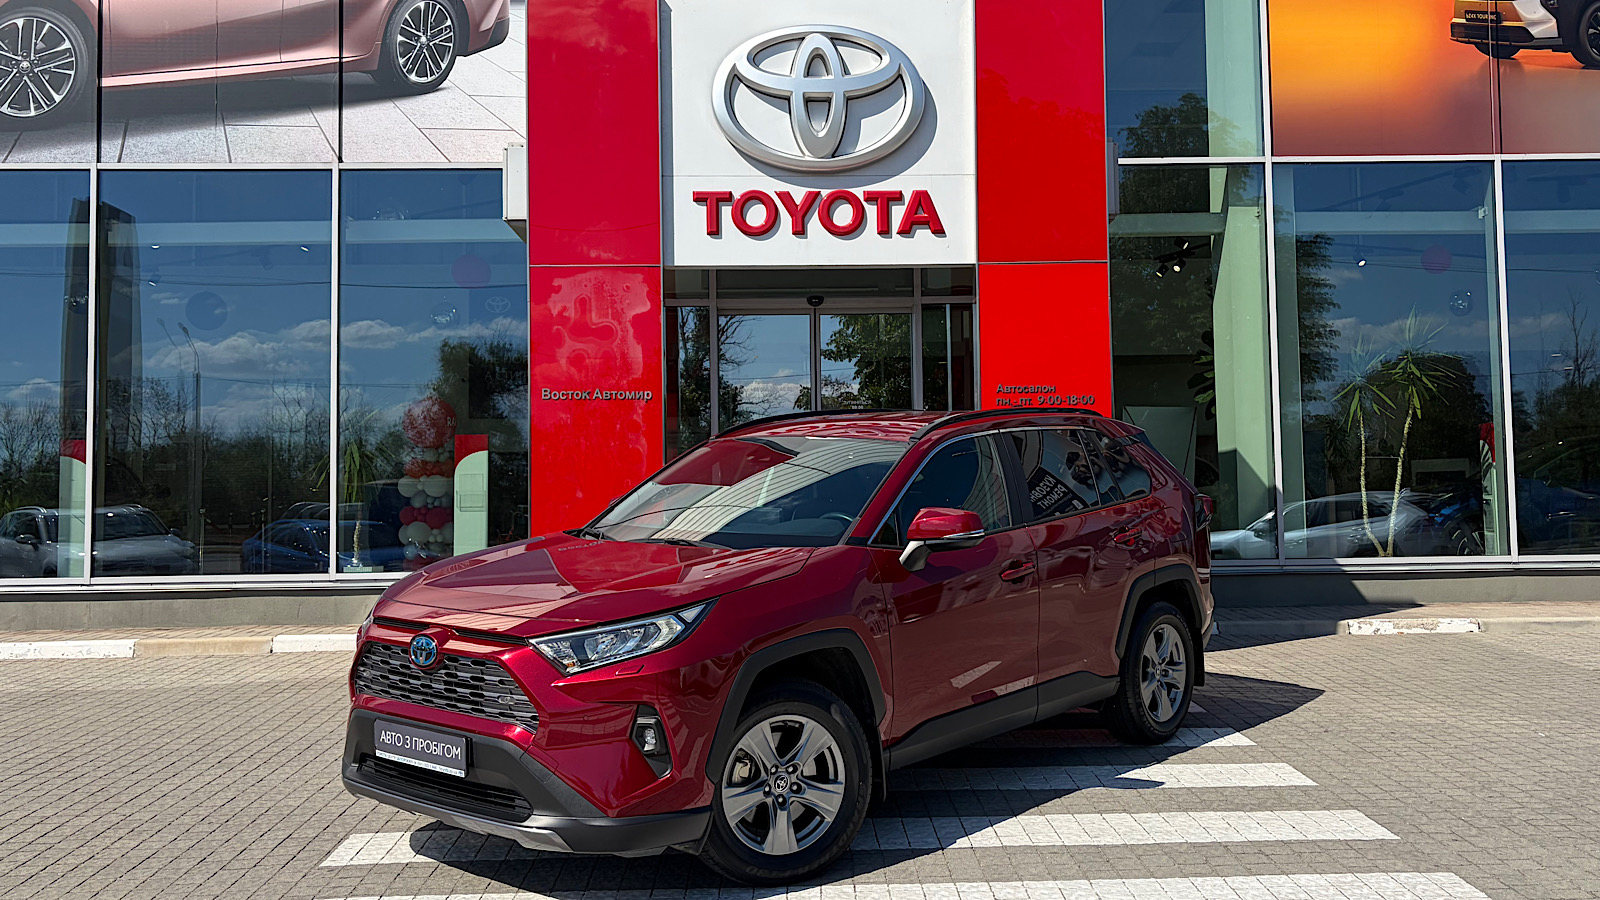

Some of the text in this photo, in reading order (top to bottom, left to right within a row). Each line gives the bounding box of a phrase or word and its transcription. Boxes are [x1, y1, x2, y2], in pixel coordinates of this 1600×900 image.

[692, 189, 947, 237] TOYOTA
[541, 387, 653, 404] Восток Автомир
[996, 384, 1056, 394] Автосалон
[380, 730, 403, 747] АВТО
[412, 737, 461, 760] ПРОБІГОМ
